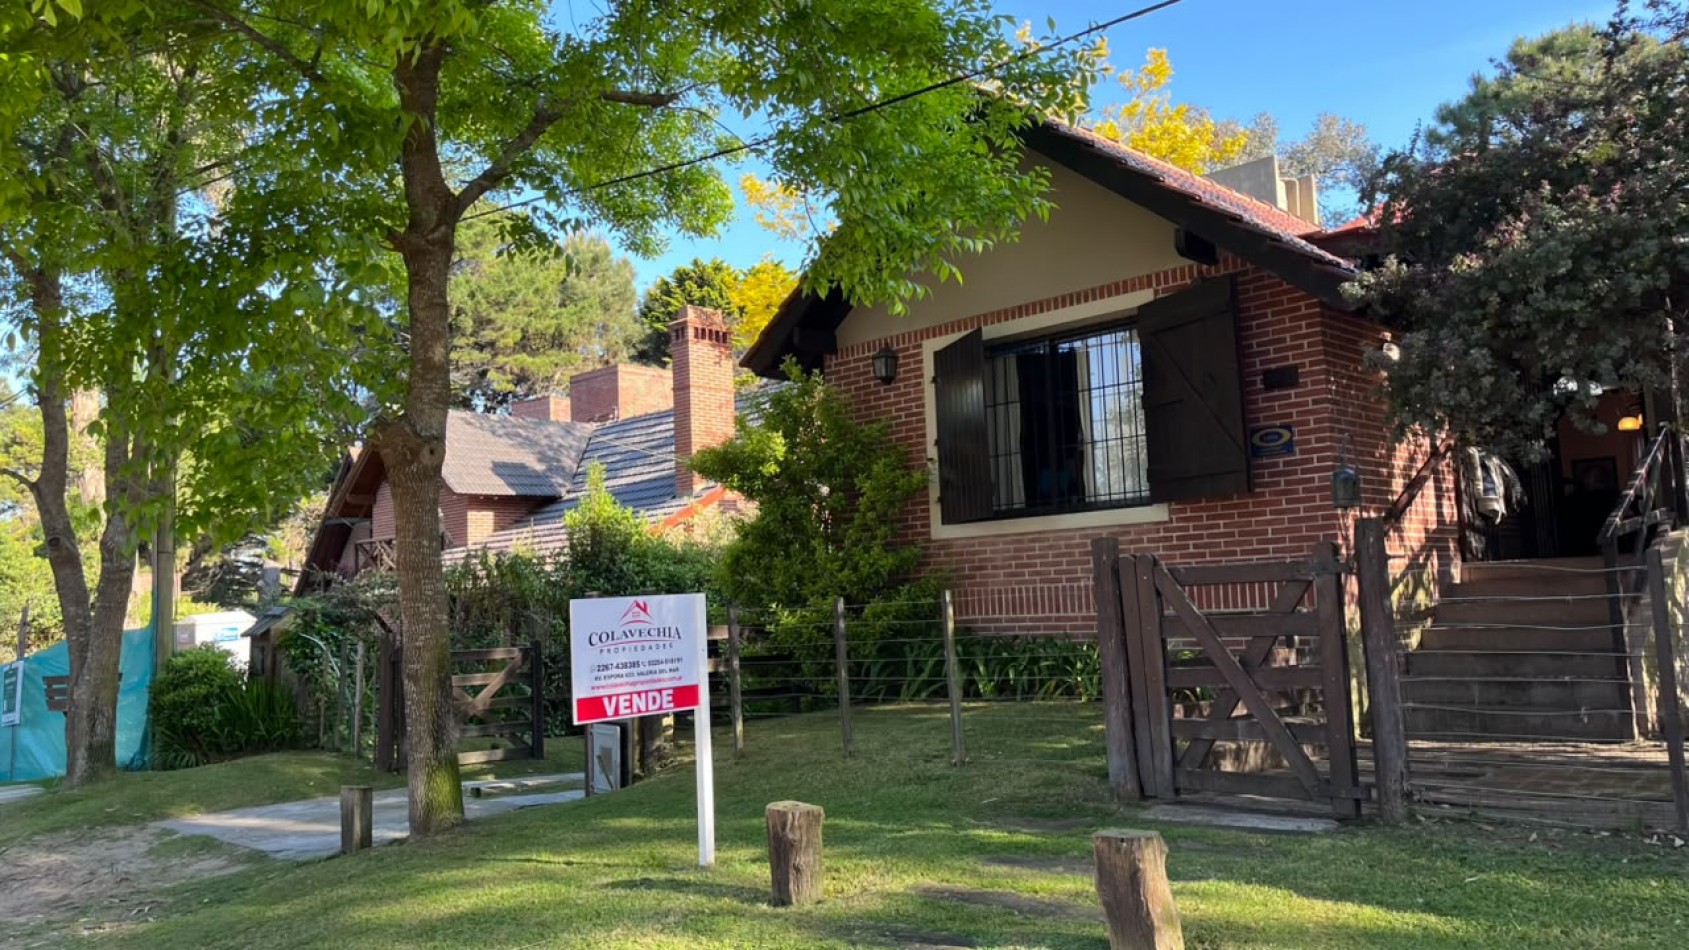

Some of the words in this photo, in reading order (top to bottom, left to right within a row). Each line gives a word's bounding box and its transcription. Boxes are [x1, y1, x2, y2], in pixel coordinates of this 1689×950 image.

[589, 626, 681, 646] COLAVECHIA
[600, 643, 673, 654] PROPIEDADES
[603, 690, 674, 716] VENDE
